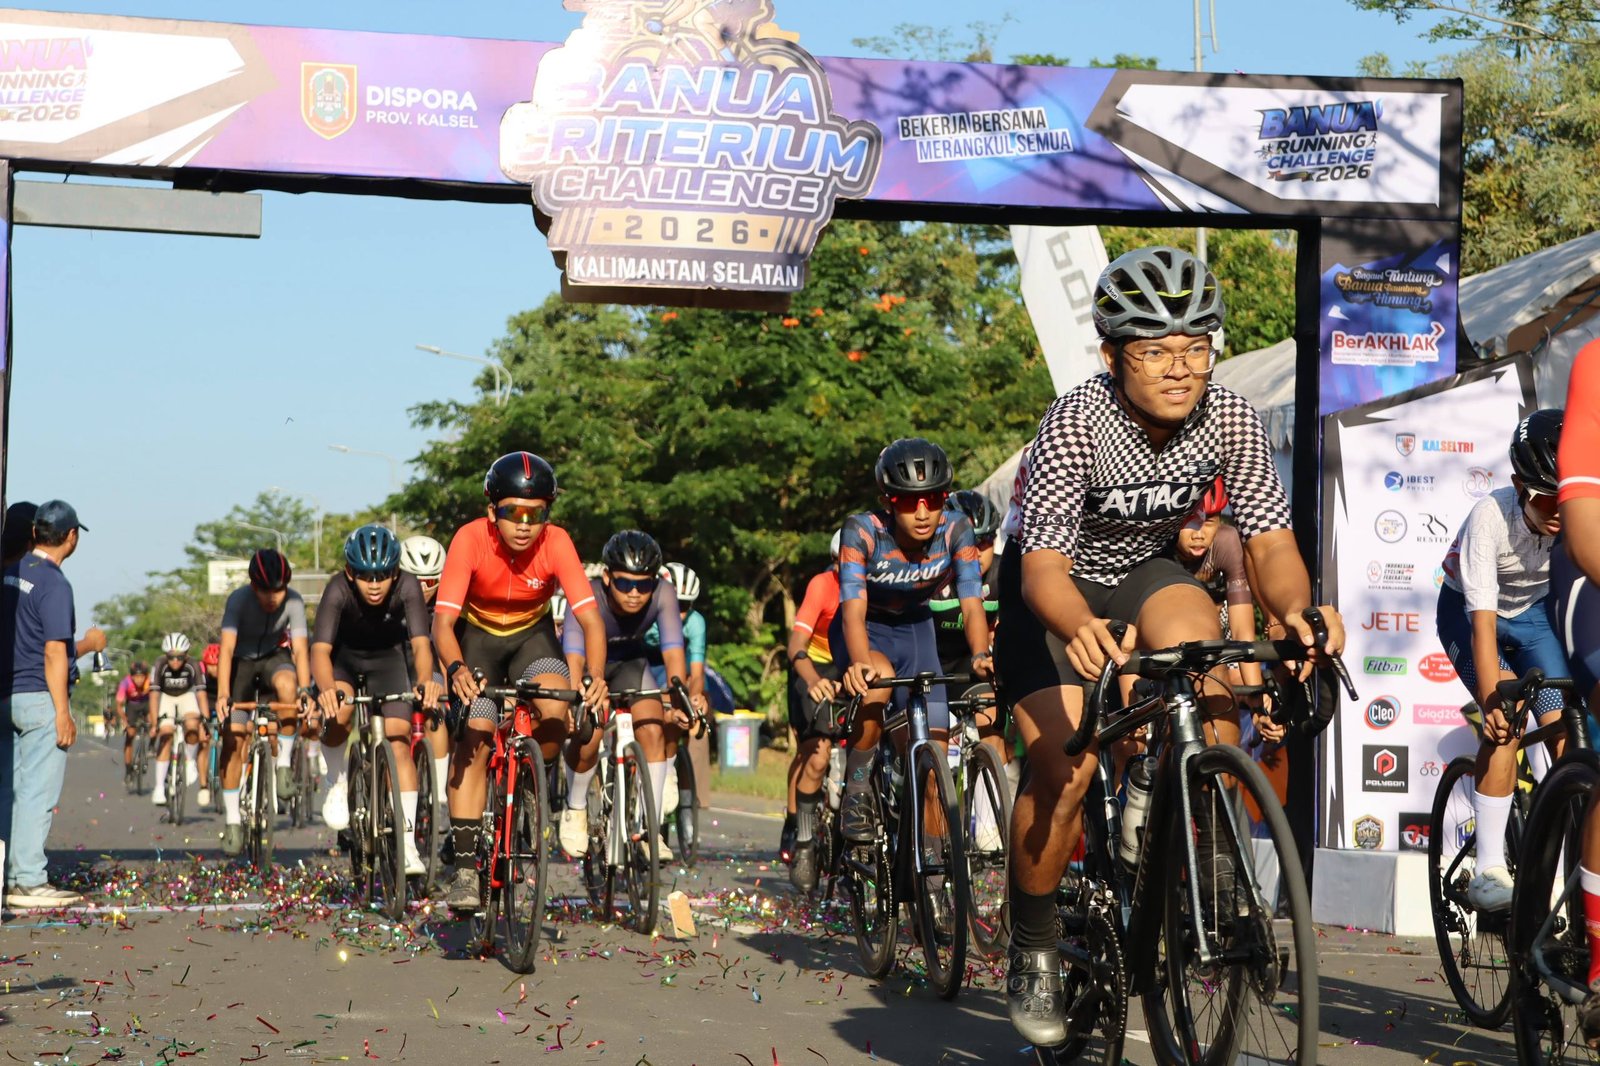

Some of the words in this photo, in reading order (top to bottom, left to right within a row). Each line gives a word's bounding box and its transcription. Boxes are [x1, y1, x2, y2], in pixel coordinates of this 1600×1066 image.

[0, 72, 75, 90] NNING
[0, 88, 86, 105] LLENGE
[366, 85, 478, 111] DISPORA
[17, 104, 81, 122] 2026
[366, 110, 412, 125] PROV.
[417, 113, 478, 129] KALSEL
[1257, 101, 1378, 139] BANUA
[900, 115, 968, 139] BEKERJA
[972, 109, 1046, 133] BERSAMA
[919, 134, 1013, 160] MERANGKUL
[1017, 131, 1071, 153] SEMUA
[1277, 134, 1367, 154] RUNNING
[1266, 149, 1376, 170] CHALLENGE
[1315, 163, 1372, 182] 2026
[550, 165, 825, 210] CHALLENGE
[573, 257, 706, 283] KALIMANTAN
[713, 262, 798, 287] SELATAN
[1334, 333, 1435, 351] BerAKHLAK
[1422, 439, 1473, 453] KALSELTRI
[1406, 475, 1435, 483] IBEST
[1361, 612, 1419, 632] JETE
[1367, 659, 1405, 672] Fitbar
[1371, 705, 1394, 721] Cleo
